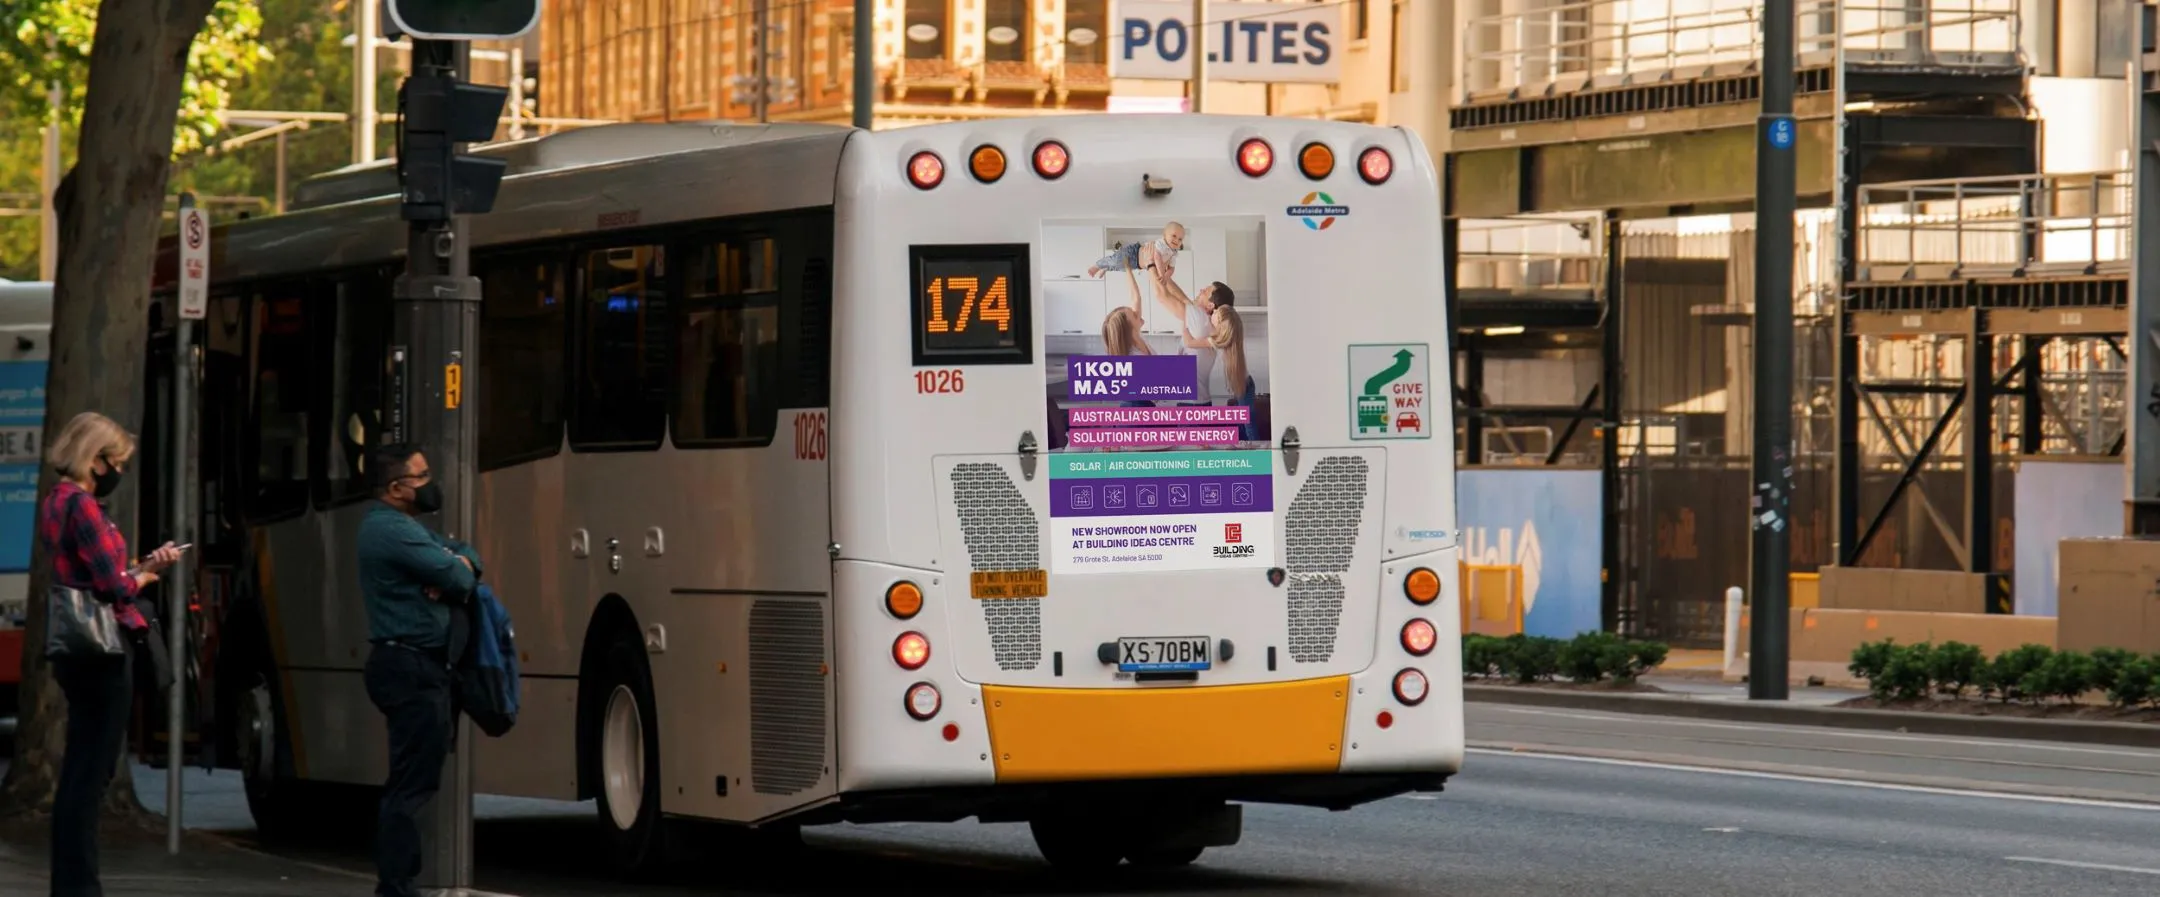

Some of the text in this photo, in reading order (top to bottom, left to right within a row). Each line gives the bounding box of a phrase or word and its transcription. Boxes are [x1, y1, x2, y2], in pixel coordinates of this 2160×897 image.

[1123, 17, 1332, 66] POITES
[926, 276, 1011, 333] 174
[914, 369, 964, 395] 1026
[1392, 383, 1423, 394] GIVE
[1140, 386, 1192, 395] AUSTRALIA
[1394, 397, 1422, 408] WAY
[1073, 409, 1247, 422] AUSTRALIA'S ONLY COMPLETE
[793, 412, 827, 461] 1026
[1073, 429, 1236, 443] SOLUTION FOR NEW ENERGY
[1070, 458, 1252, 472] SOLAR AIR CONDITIONING ELECTRICAL
[1072, 523, 1198, 537] NEW SHOWROOM NOW OPEN
[1072, 536, 1195, 549] AT BUILDING IDEAS CENTRE
[1212, 545, 1255, 555] BUILDING
[1085, 555, 1102, 564] Grote
[1112, 554, 1138, 563] Adelaide
[1138, 554, 1147, 563] SA
[1147, 553, 1163, 562] 5000
[974, 572, 985, 584] DO
[1003, 570, 1043, 583] OVERTAKE
